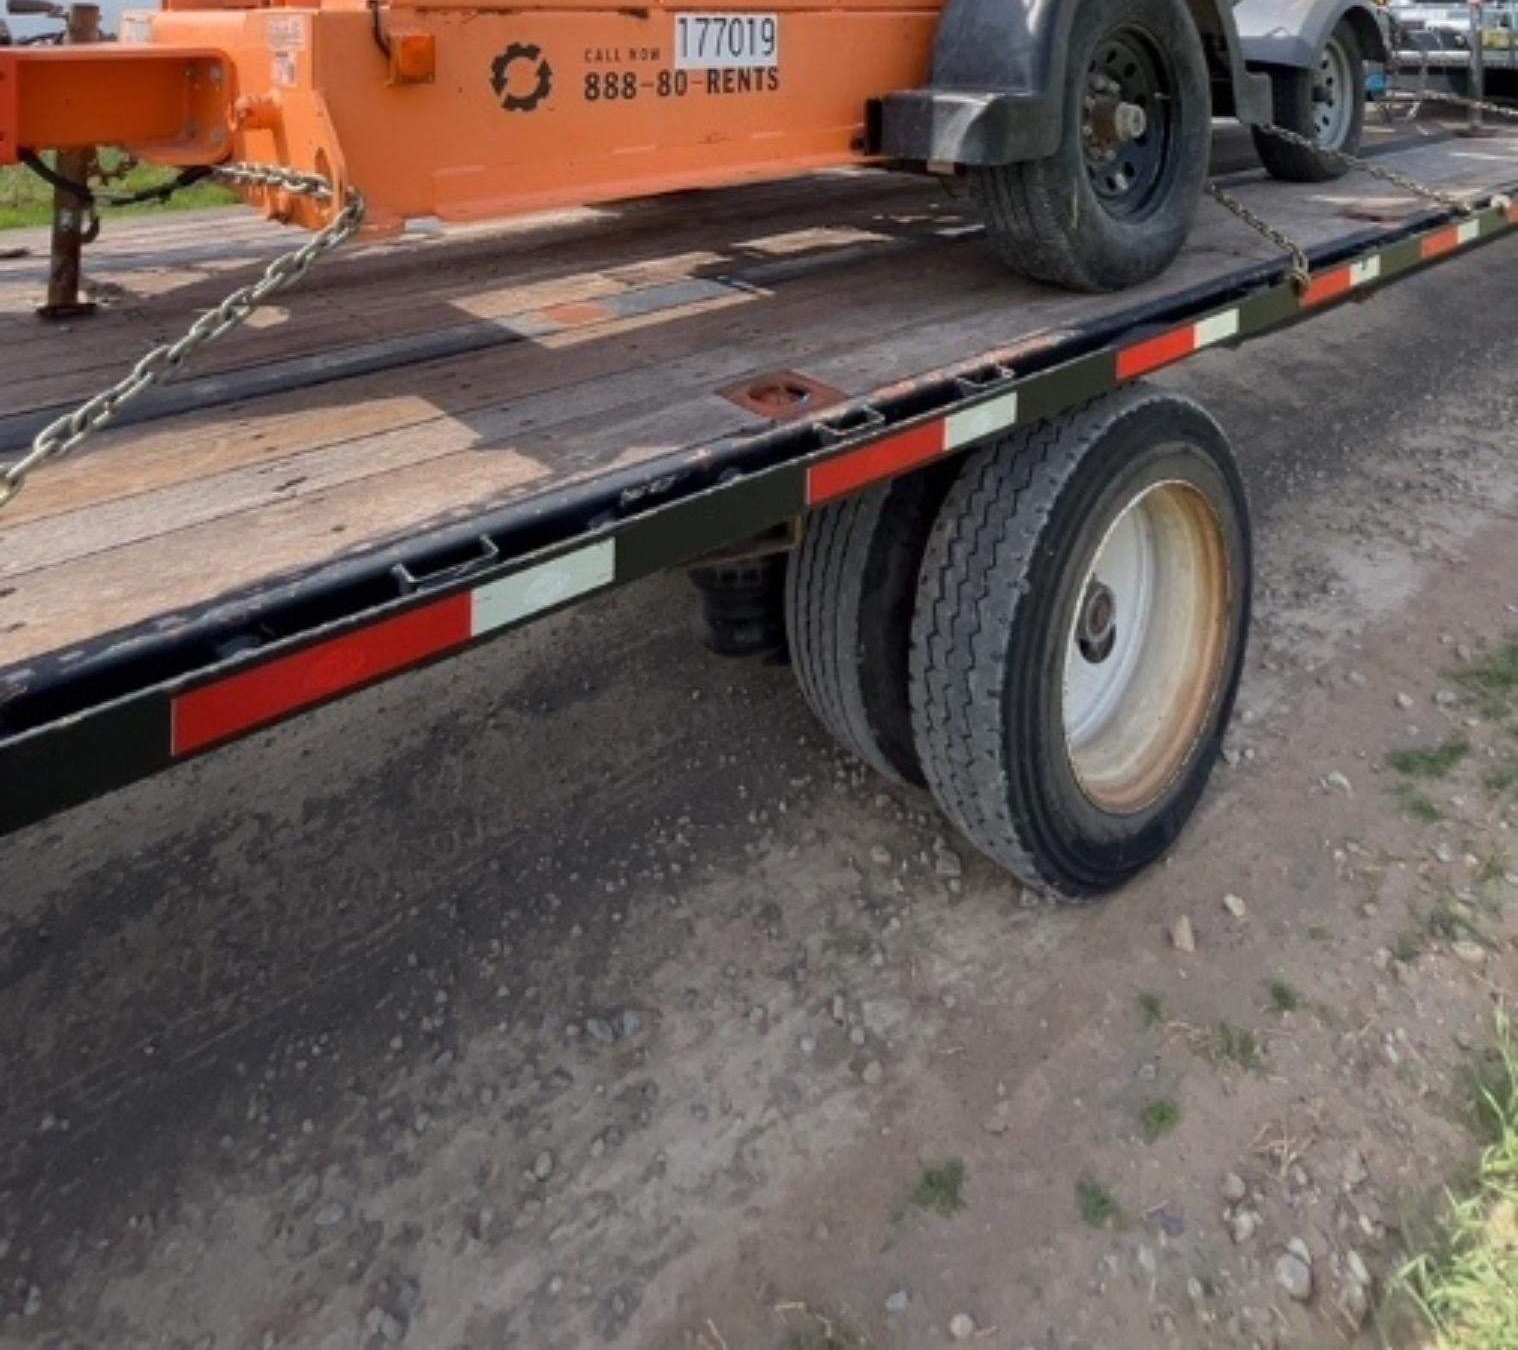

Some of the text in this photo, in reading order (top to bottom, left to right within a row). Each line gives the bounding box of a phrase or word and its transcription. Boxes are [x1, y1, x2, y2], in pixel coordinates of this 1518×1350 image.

[678, 17, 775, 57] 177019
[585, 49, 661, 63] CALL NOW
[584, 68, 779, 101] 888-80-RENTS
